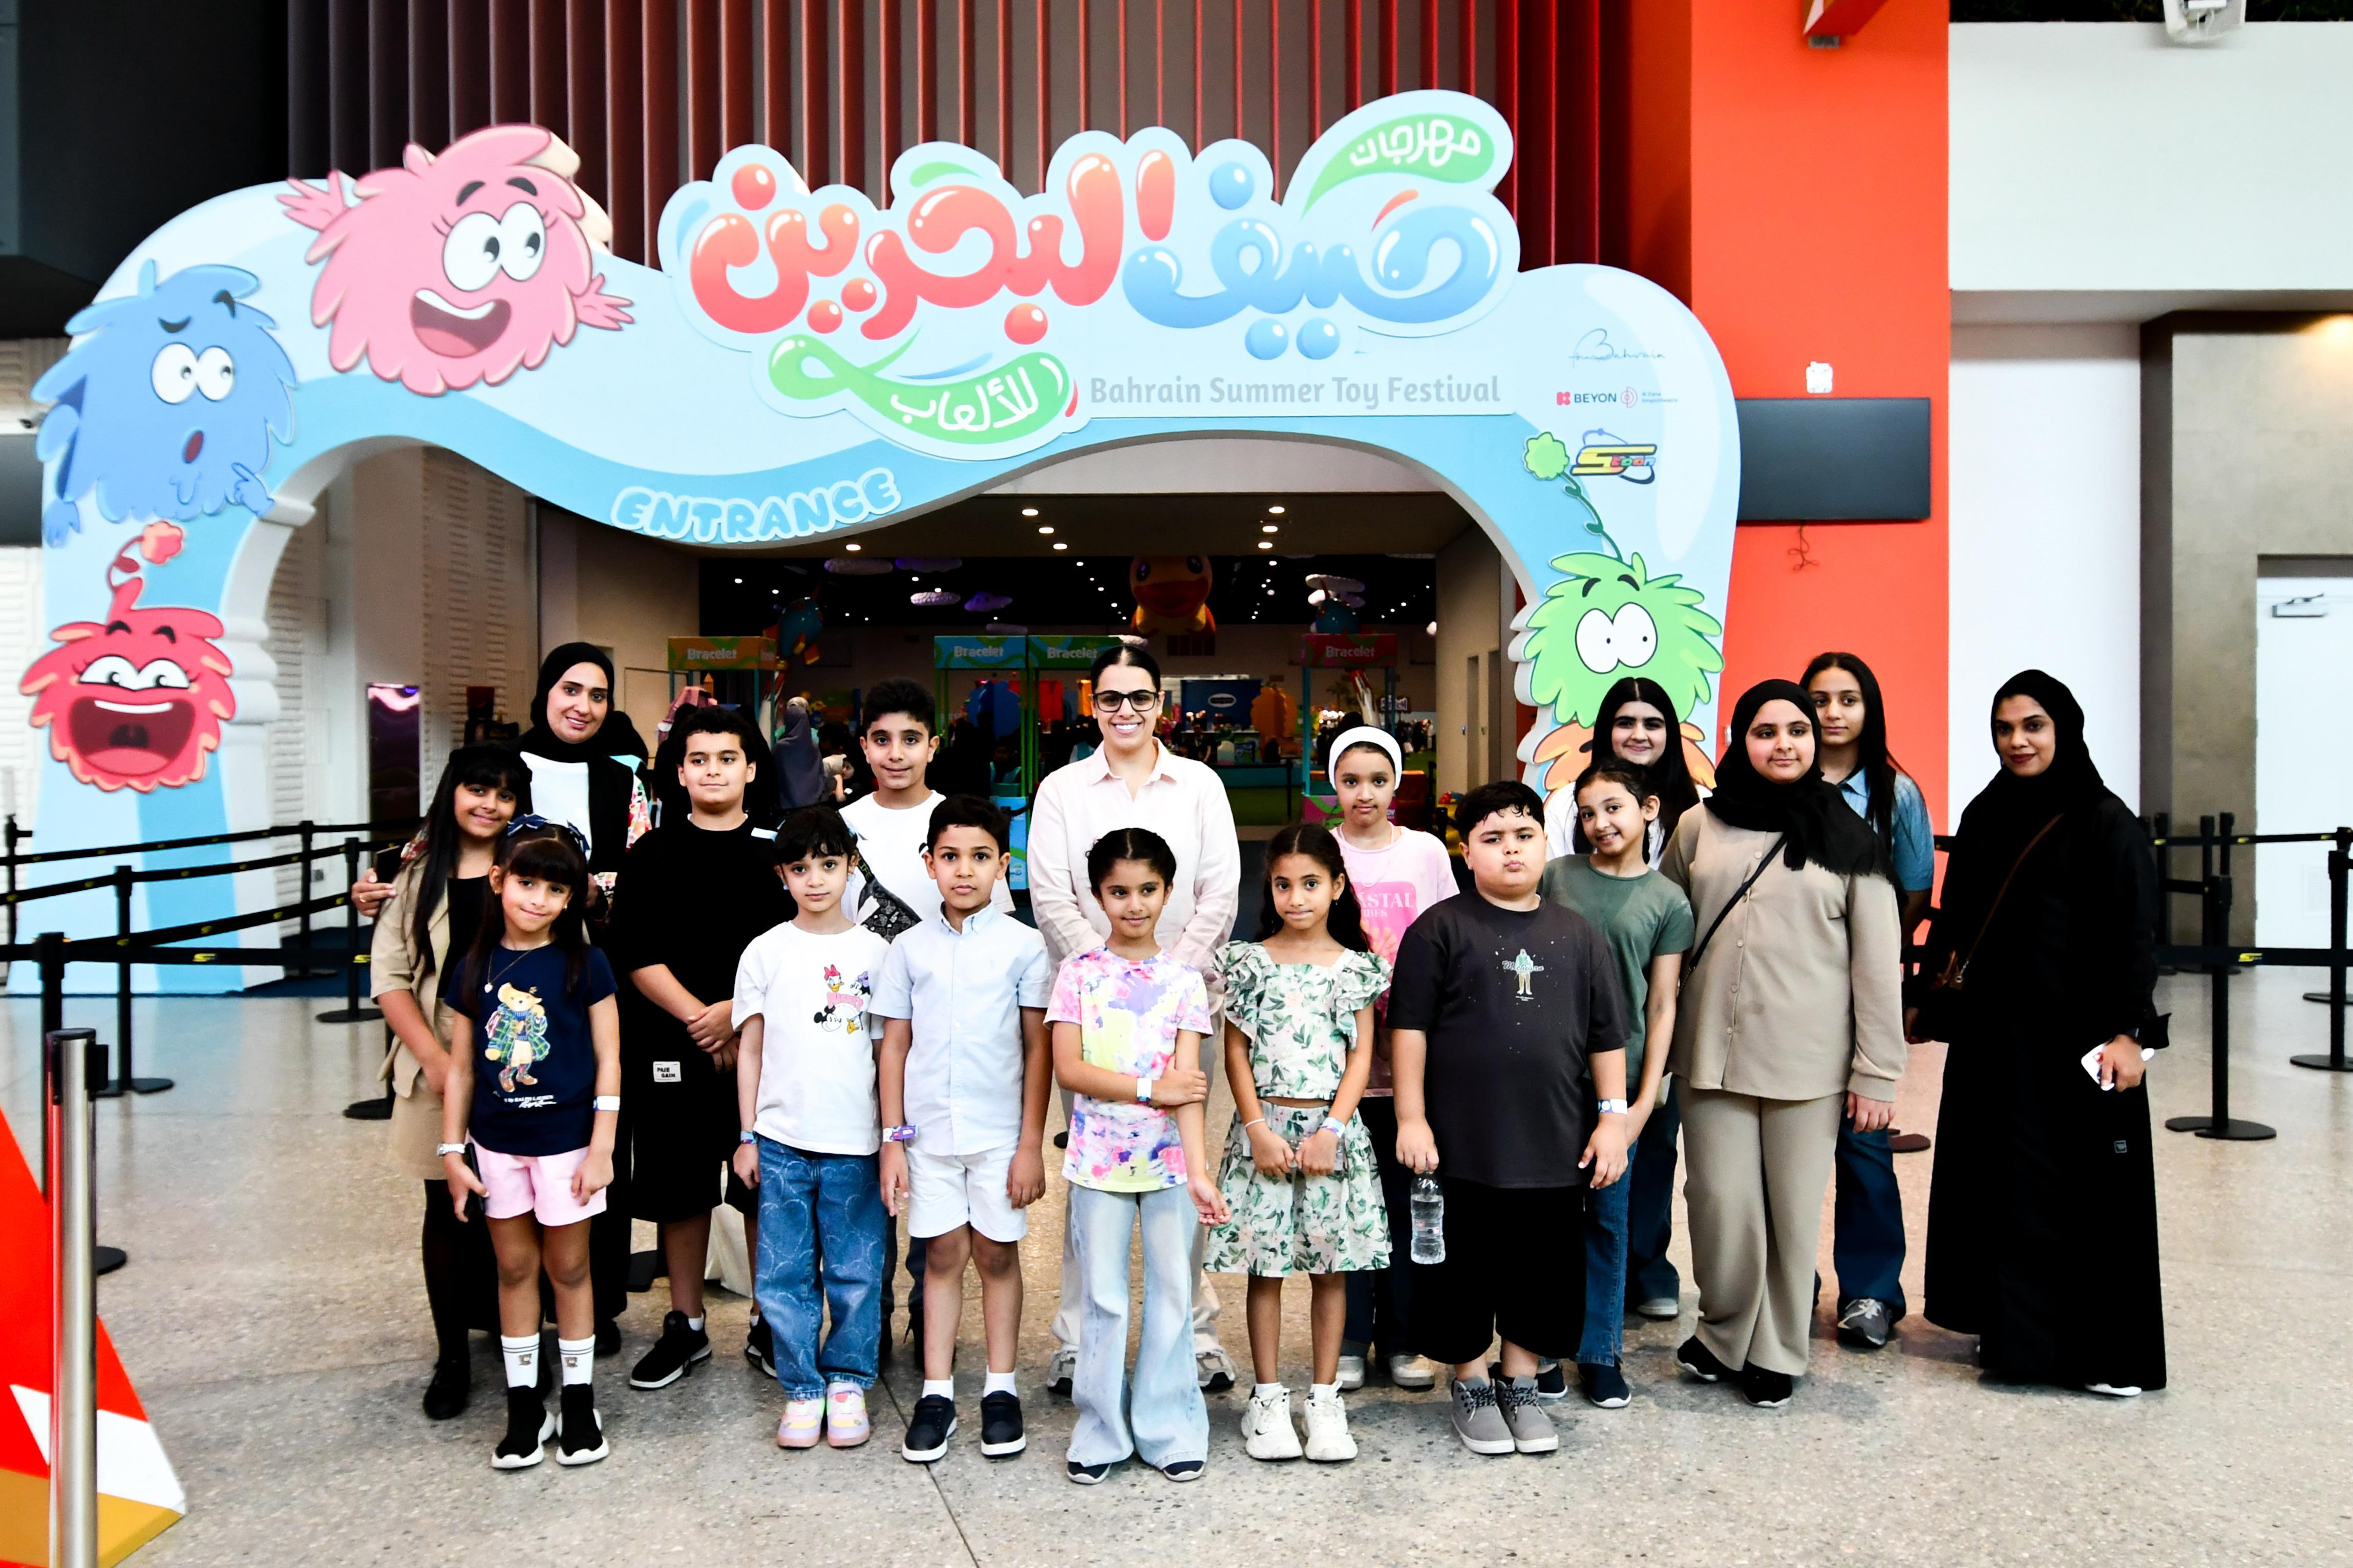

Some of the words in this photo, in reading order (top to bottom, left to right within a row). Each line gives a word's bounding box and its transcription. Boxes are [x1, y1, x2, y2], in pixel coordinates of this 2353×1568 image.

[1349, 119, 1481, 167] مهرجان
[690, 148, 1175, 346] البحرين
[1122, 161, 1502, 360] صيف
[890, 366, 1039, 432] للألعاب
[1091, 376, 1201, 403] Bahrain
[1210, 376, 1325, 403] Summer
[1332, 376, 1379, 410] Toy
[1388, 374, 1501, 402] Festival
[1574, 393, 1617, 403] BEYON
[612, 468, 902, 542] ENTRANCE
[687, 648, 737, 660] Bracelet
[953, 646, 1004, 657] Bracelet
[1047, 647, 1098, 659] Bracelet
[1326, 645, 1375, 657] Bracelet
[1363, 909, 1388, 917] IBES
